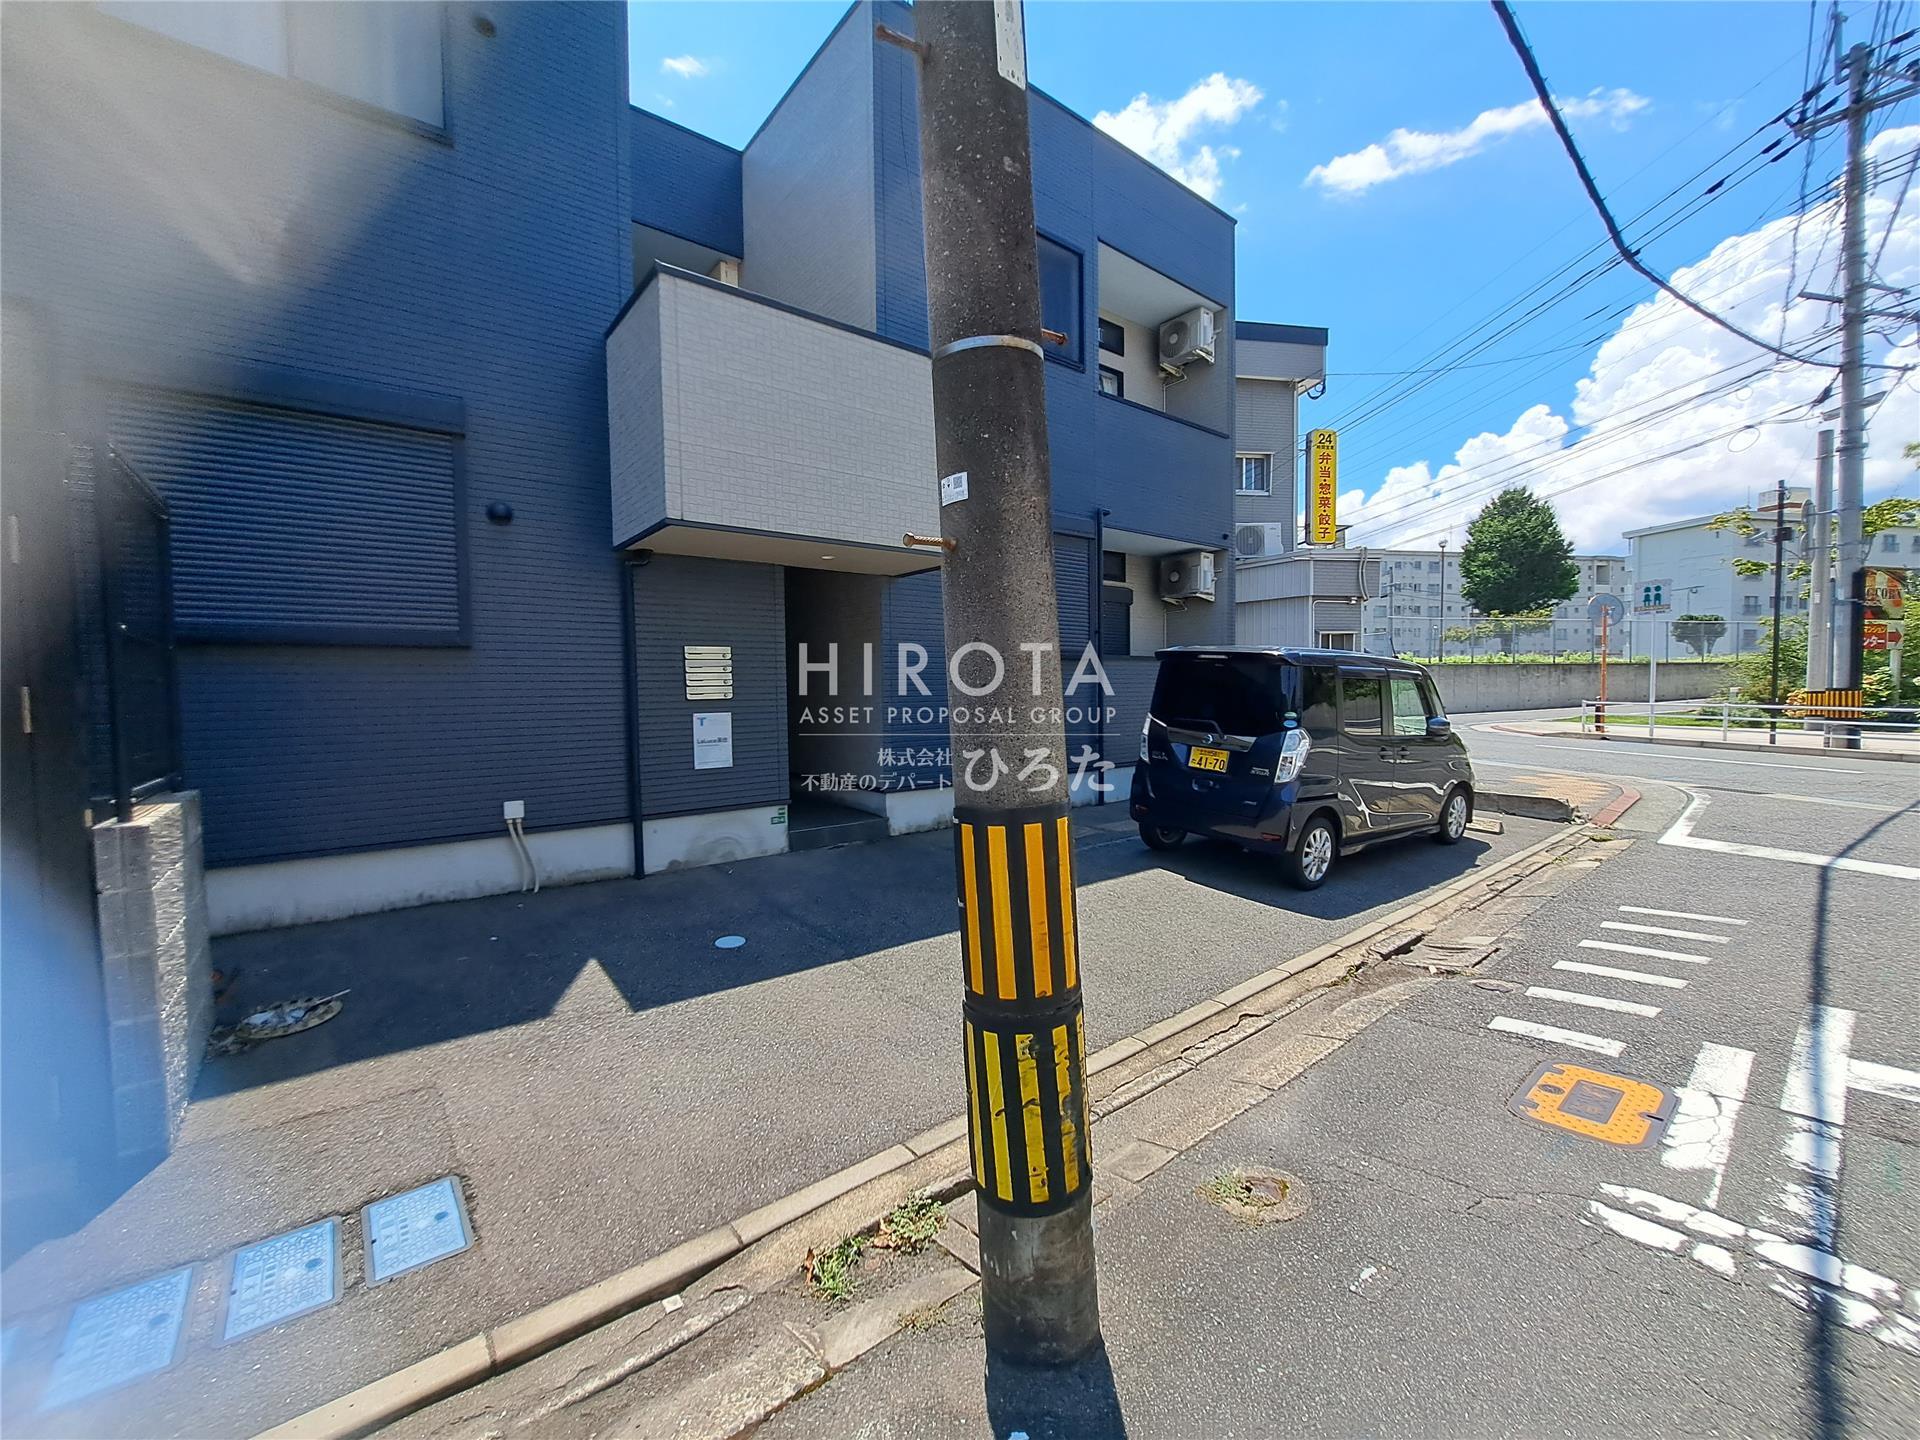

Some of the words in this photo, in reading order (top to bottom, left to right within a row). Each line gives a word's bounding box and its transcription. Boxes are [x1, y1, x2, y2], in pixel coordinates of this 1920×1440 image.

[1318, 433, 1332, 445] 24
[1863, 634, 1886, 647] ンター
[1196, 756, 1226, 771] 41-70
